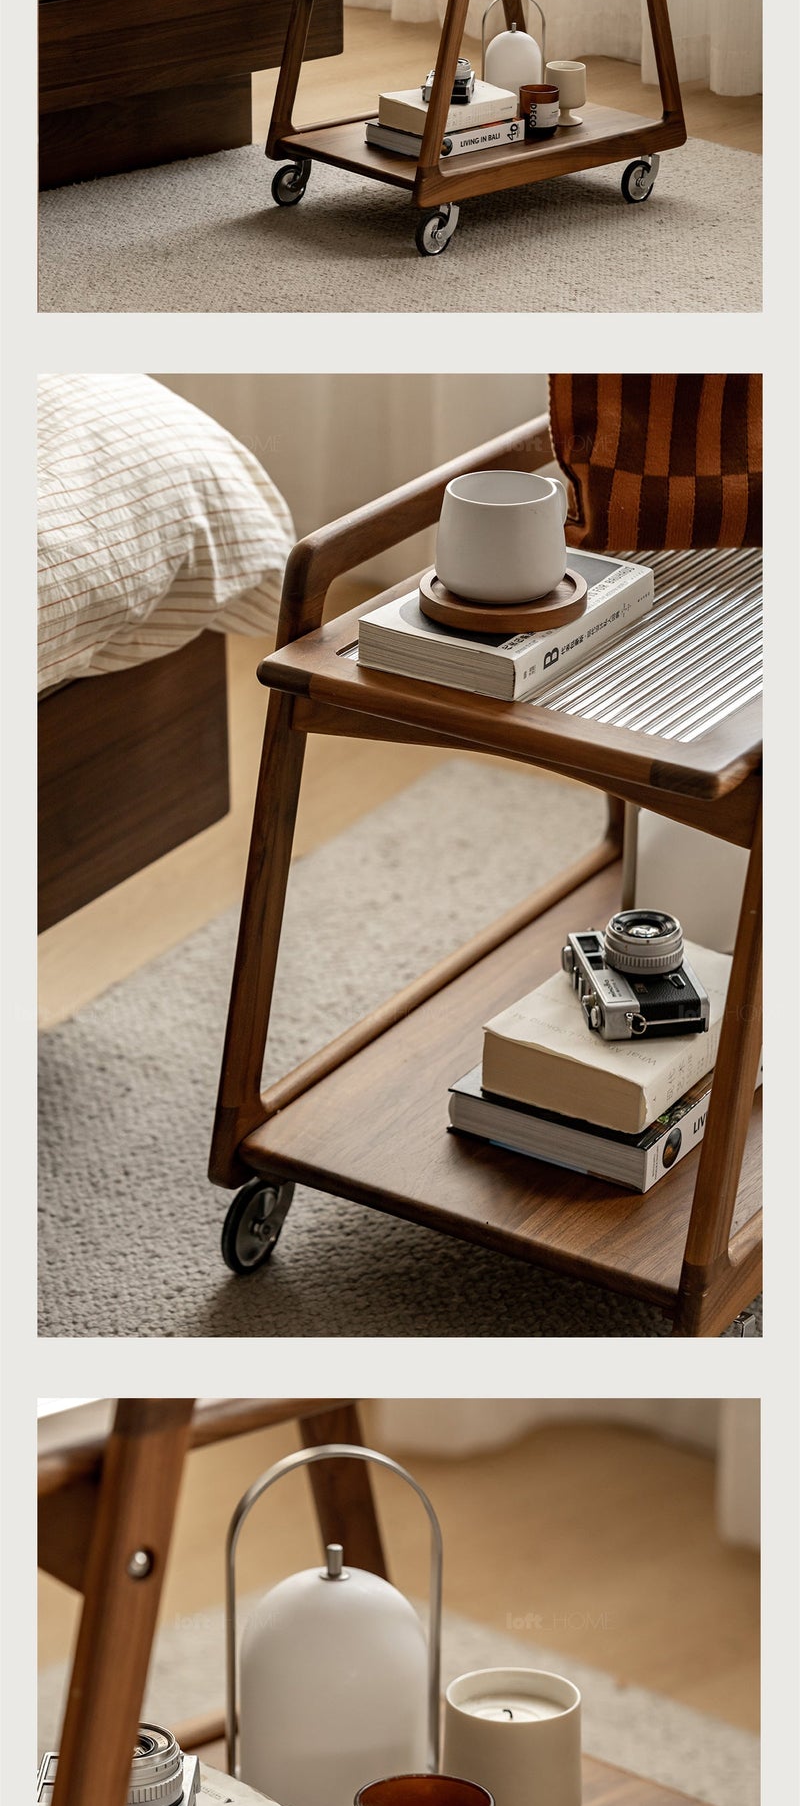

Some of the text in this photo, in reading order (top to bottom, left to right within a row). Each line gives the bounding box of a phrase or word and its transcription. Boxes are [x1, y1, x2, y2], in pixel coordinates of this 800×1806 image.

[529, 104, 537, 127] DECO
[460, 133, 500, 147] LIVING IN BALI
[543, 647, 559, 670] B
